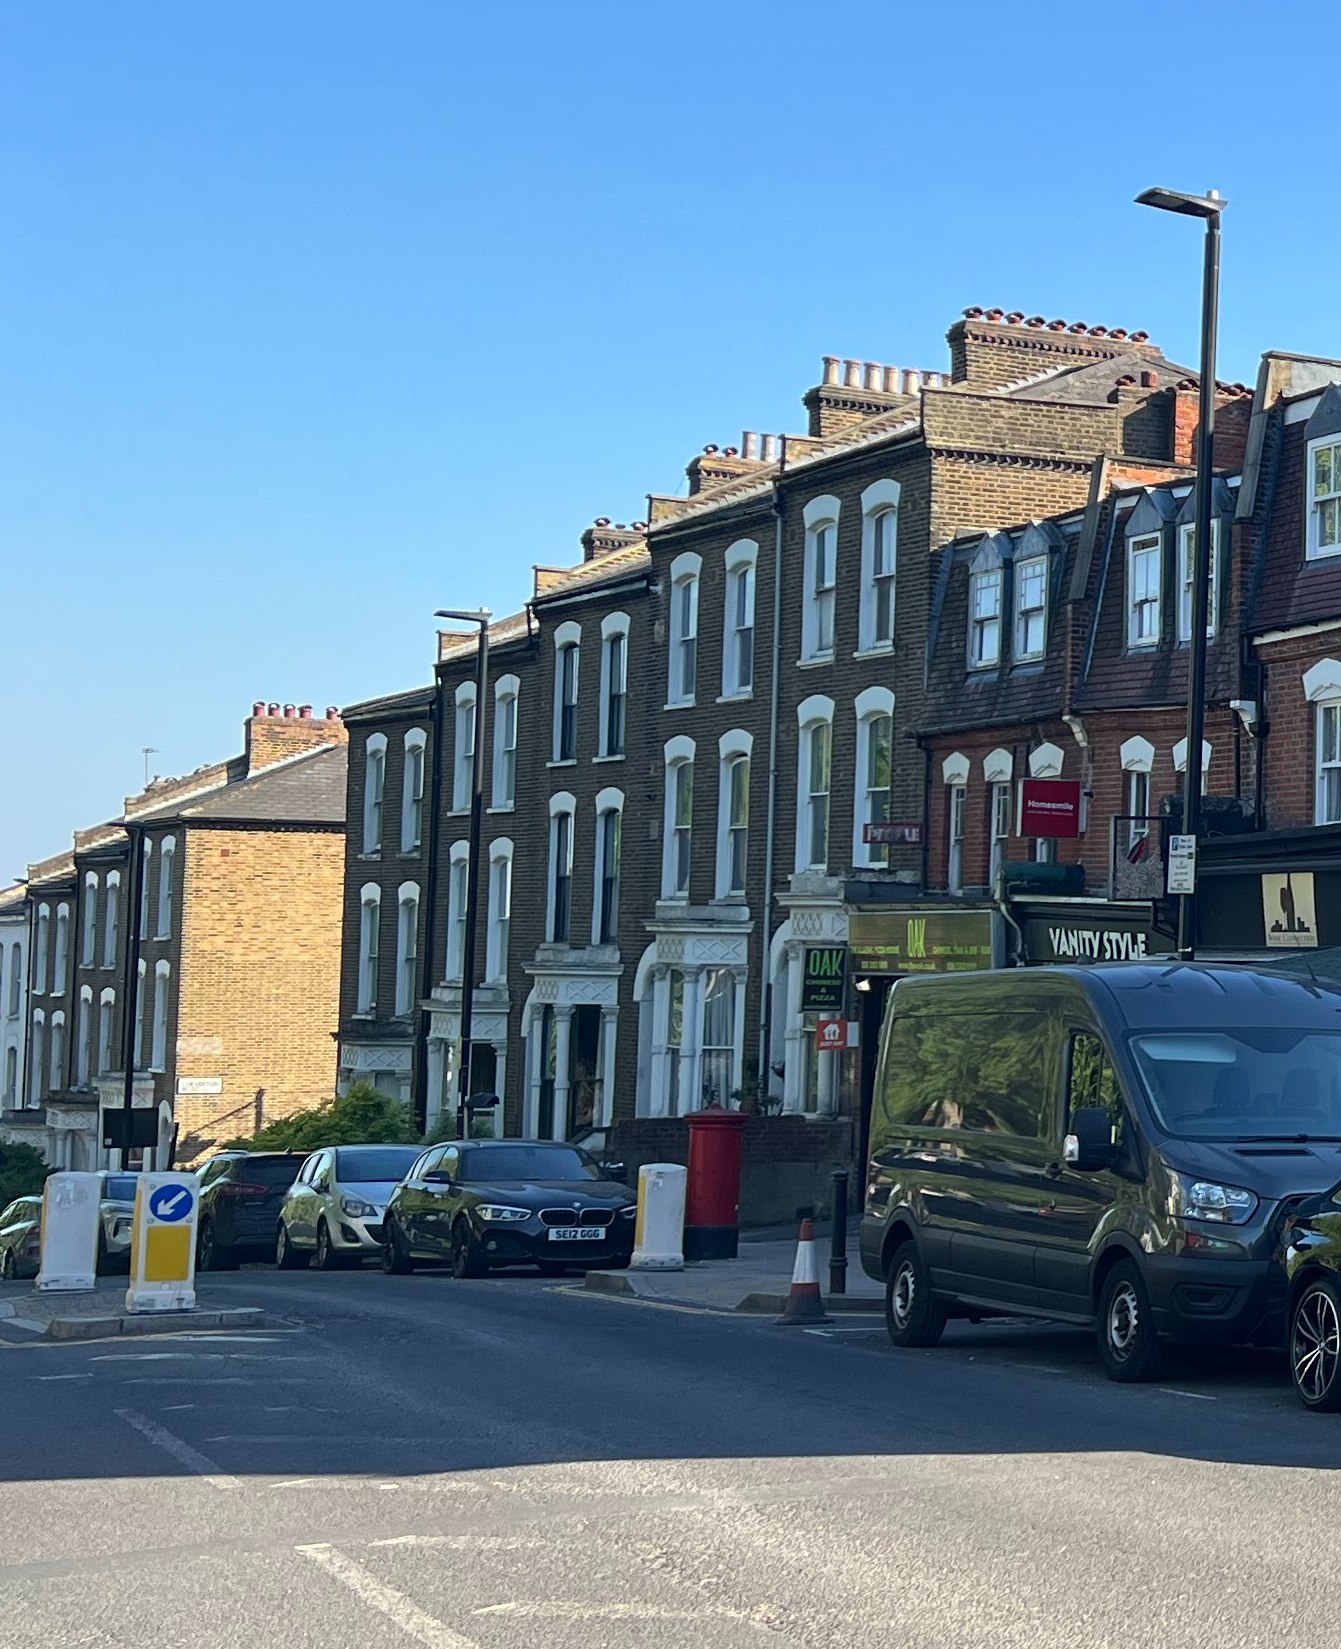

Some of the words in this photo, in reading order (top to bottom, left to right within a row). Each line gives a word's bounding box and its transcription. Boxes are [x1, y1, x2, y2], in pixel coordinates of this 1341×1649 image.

[907, 918, 926, 958] OAK
[1048, 927, 1100, 959] VANITY
[1102, 931, 1147, 960] STYLE
[809, 949, 844, 976] OAK
